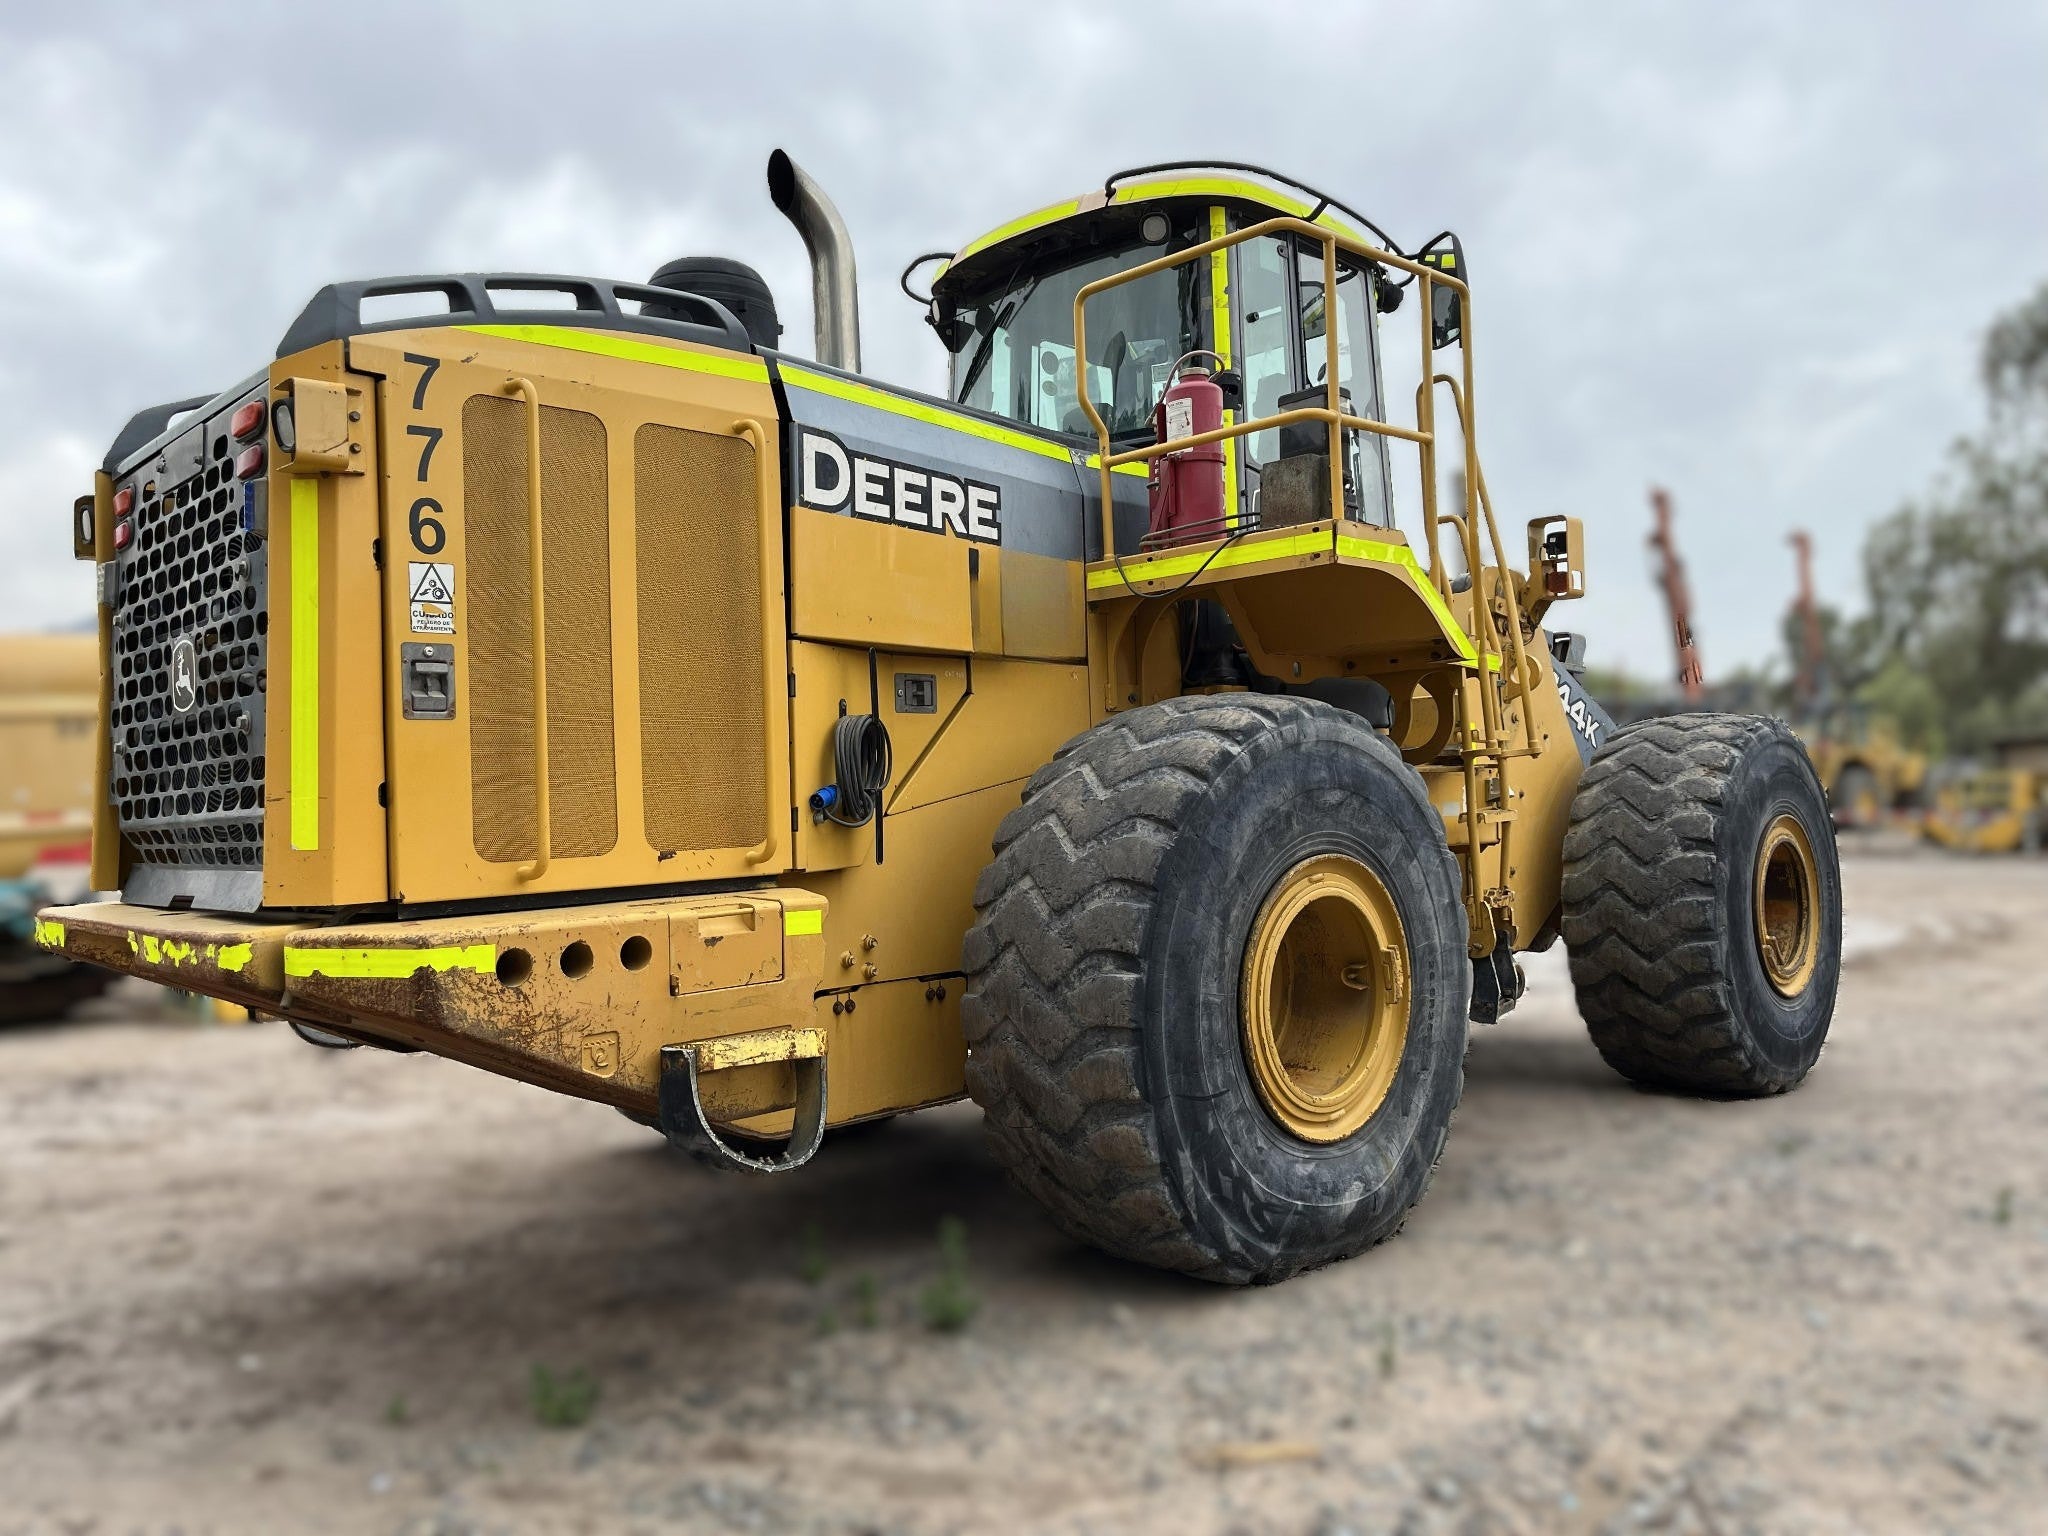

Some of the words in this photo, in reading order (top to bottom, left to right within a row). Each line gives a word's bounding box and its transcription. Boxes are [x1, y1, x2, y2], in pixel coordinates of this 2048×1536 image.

[404, 352, 446, 555] 776
[802, 432, 999, 541] DEERE
[1553, 671, 1600, 749] 44K
